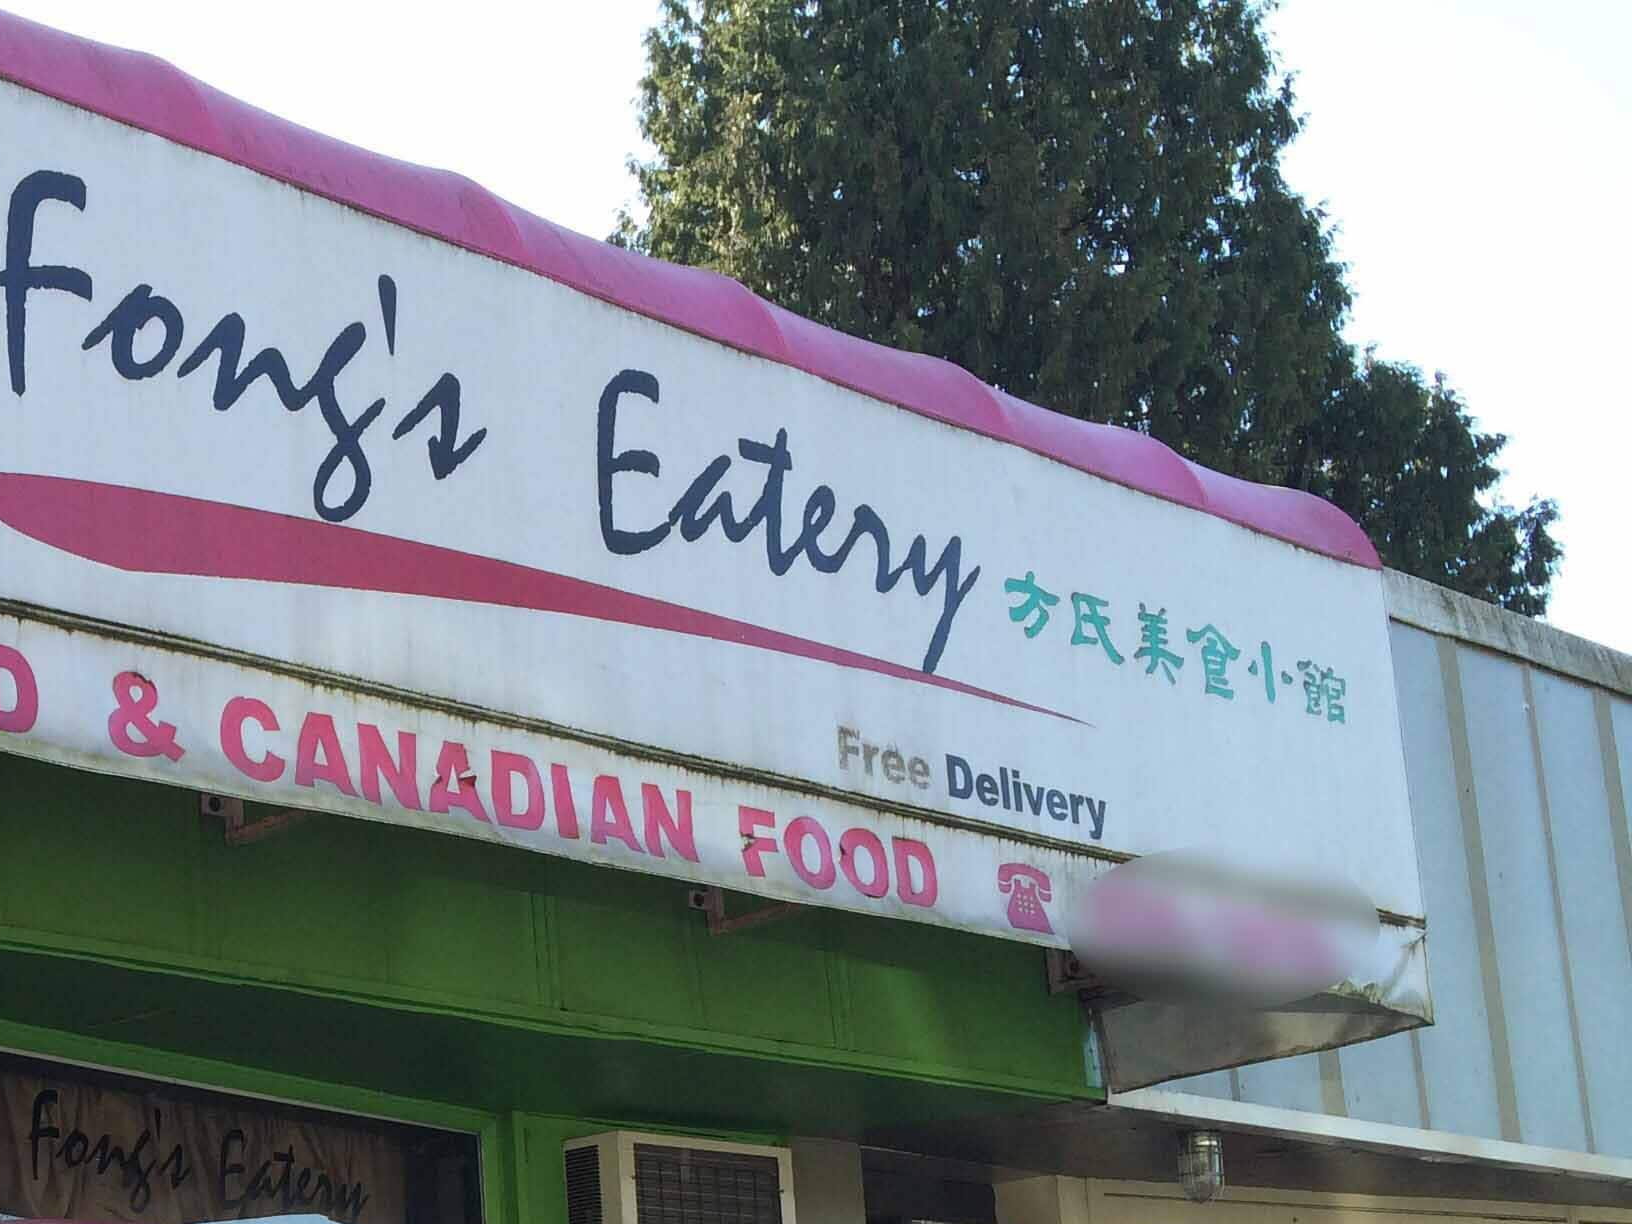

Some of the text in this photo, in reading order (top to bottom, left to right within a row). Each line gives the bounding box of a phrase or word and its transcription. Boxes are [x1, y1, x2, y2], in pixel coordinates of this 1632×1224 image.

[597, 369, 980, 673] Eatery
[1004, 571, 1346, 723] 方氏美食小館
[108, 670, 185, 762] &
[220, 697, 699, 863] CANADIAN
[739, 805, 938, 908] FOOD
[837, 726, 1106, 840] Free Delivery
